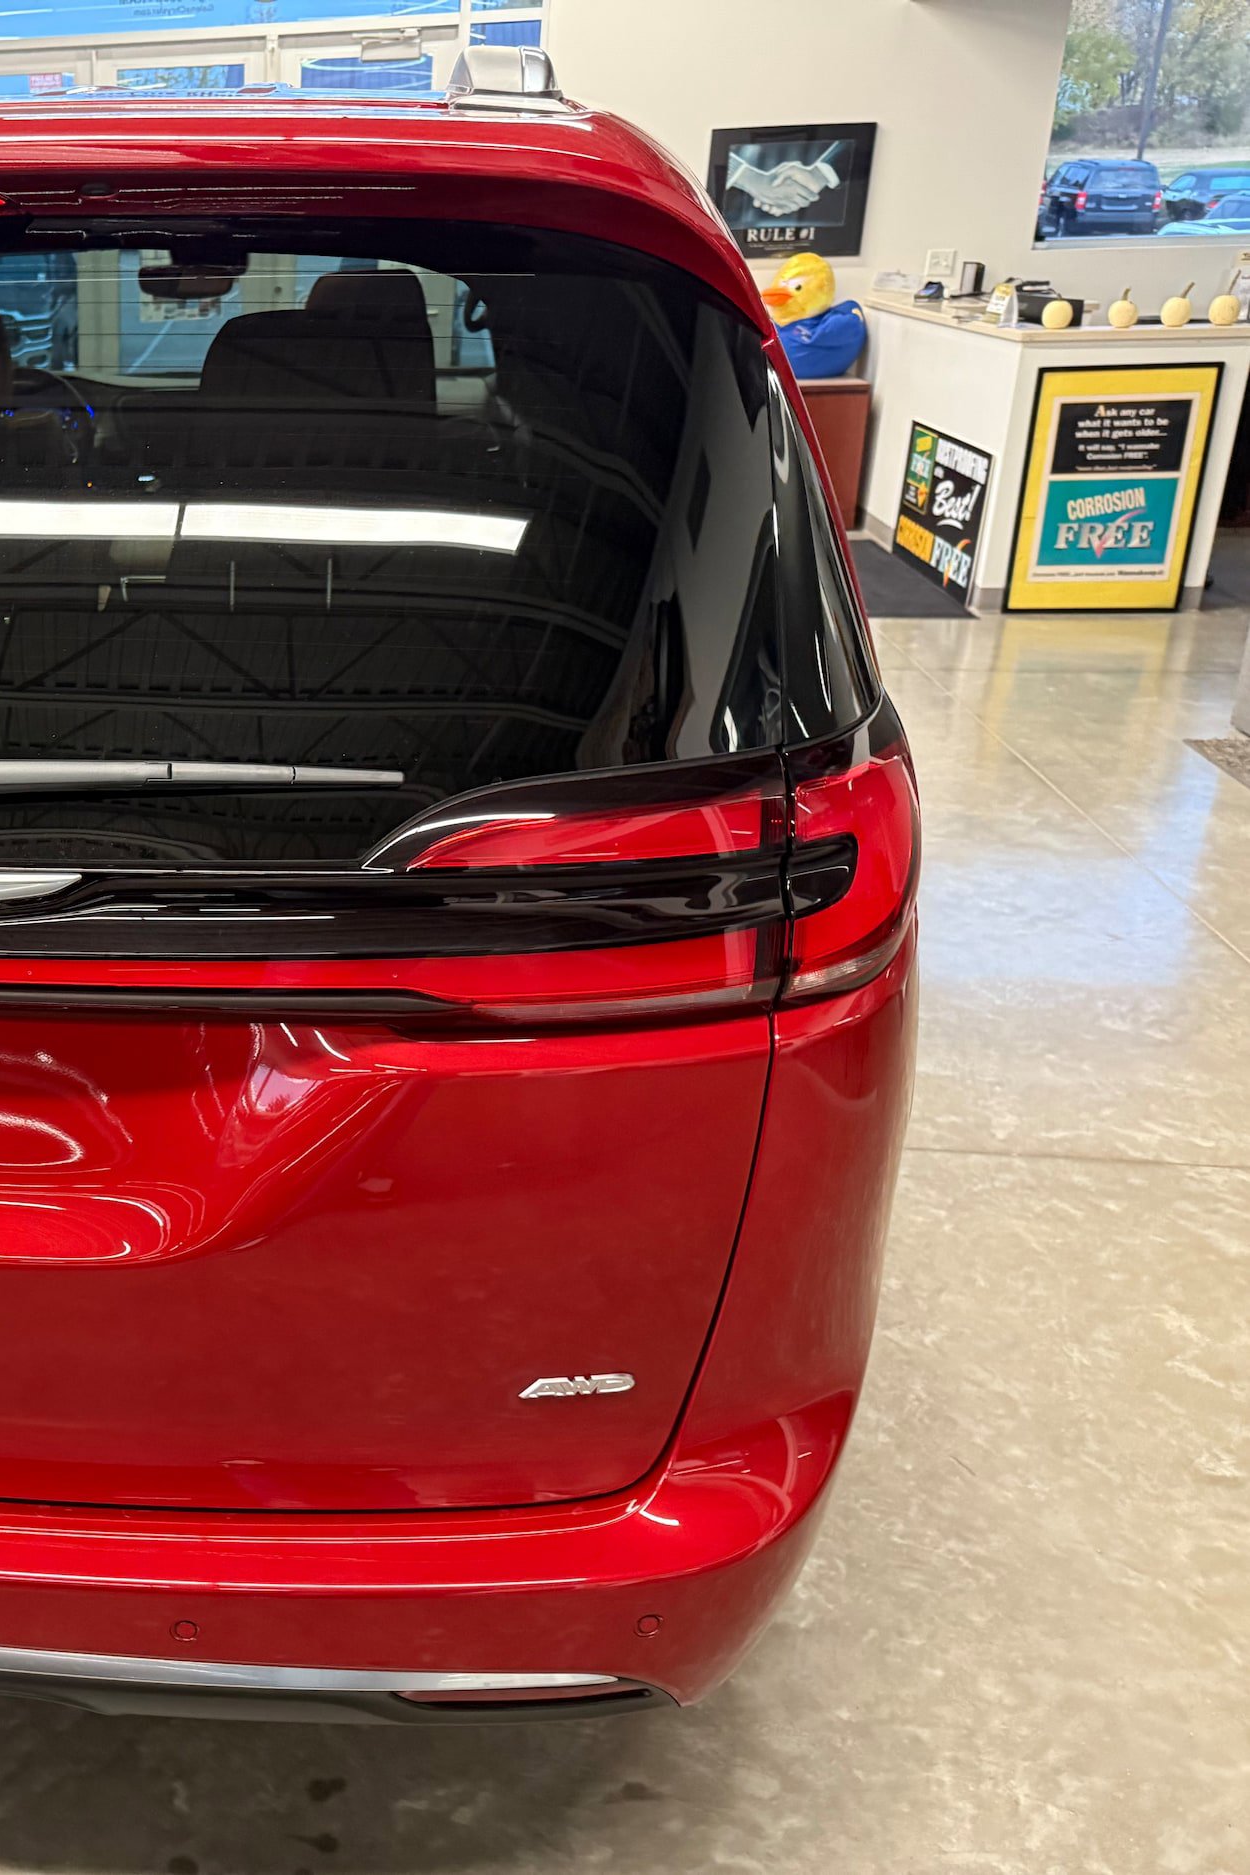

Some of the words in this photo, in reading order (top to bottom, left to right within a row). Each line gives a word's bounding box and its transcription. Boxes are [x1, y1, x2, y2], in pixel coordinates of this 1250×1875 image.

[747, 228, 796, 242] RULE
[1077, 420, 1101, 428] what
[1102, 419, 1111, 428] it
[1112, 419, 1142, 427] wants
[1143, 418, 1155, 426] to
[1156, 417, 1169, 426] be
[1094, 405, 1118, 417] Ask
[1119, 408, 1137, 417] any
[1139, 408, 1156, 416] car
[1075, 430, 1100, 438] when
[1101, 429, 1110, 438] it
[1111, 429, 1133, 439] gets
[932, 479, 982, 522] Best!
[1067, 487, 1146, 520] CORROSION
[1054, 521, 1154, 550] FREE
[931, 535, 972, 589] FREE
[518, 1373, 635, 1399] AWD
